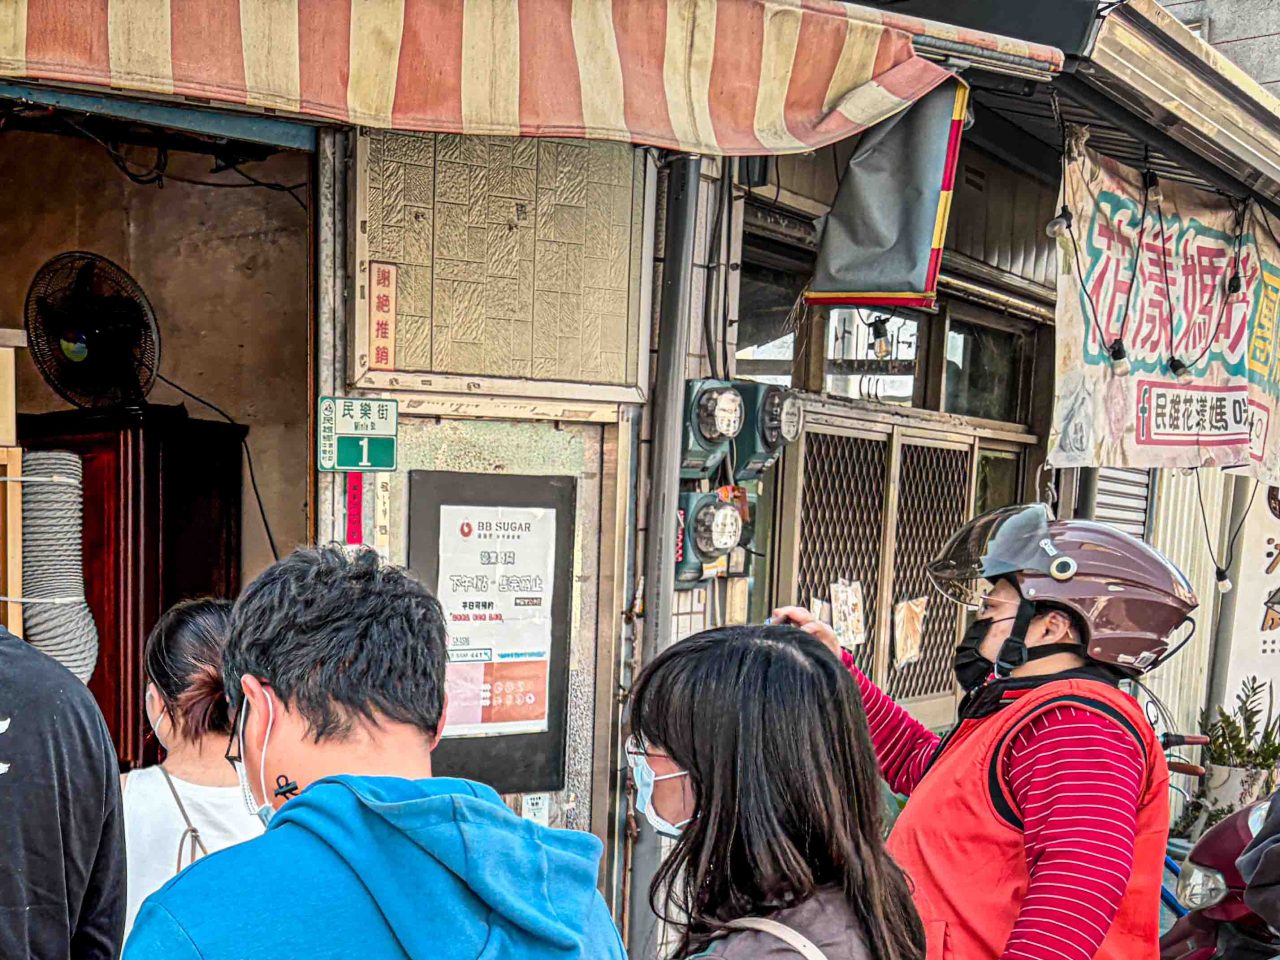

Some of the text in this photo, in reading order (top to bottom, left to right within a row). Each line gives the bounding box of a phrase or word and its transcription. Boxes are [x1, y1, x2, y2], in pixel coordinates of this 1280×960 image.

[374, 267, 391, 367] 謝絕推銷
[341, 401, 389, 420] 民樂街
[358, 437, 372, 466] 1
[477, 521, 531, 532] BB SUGAR
